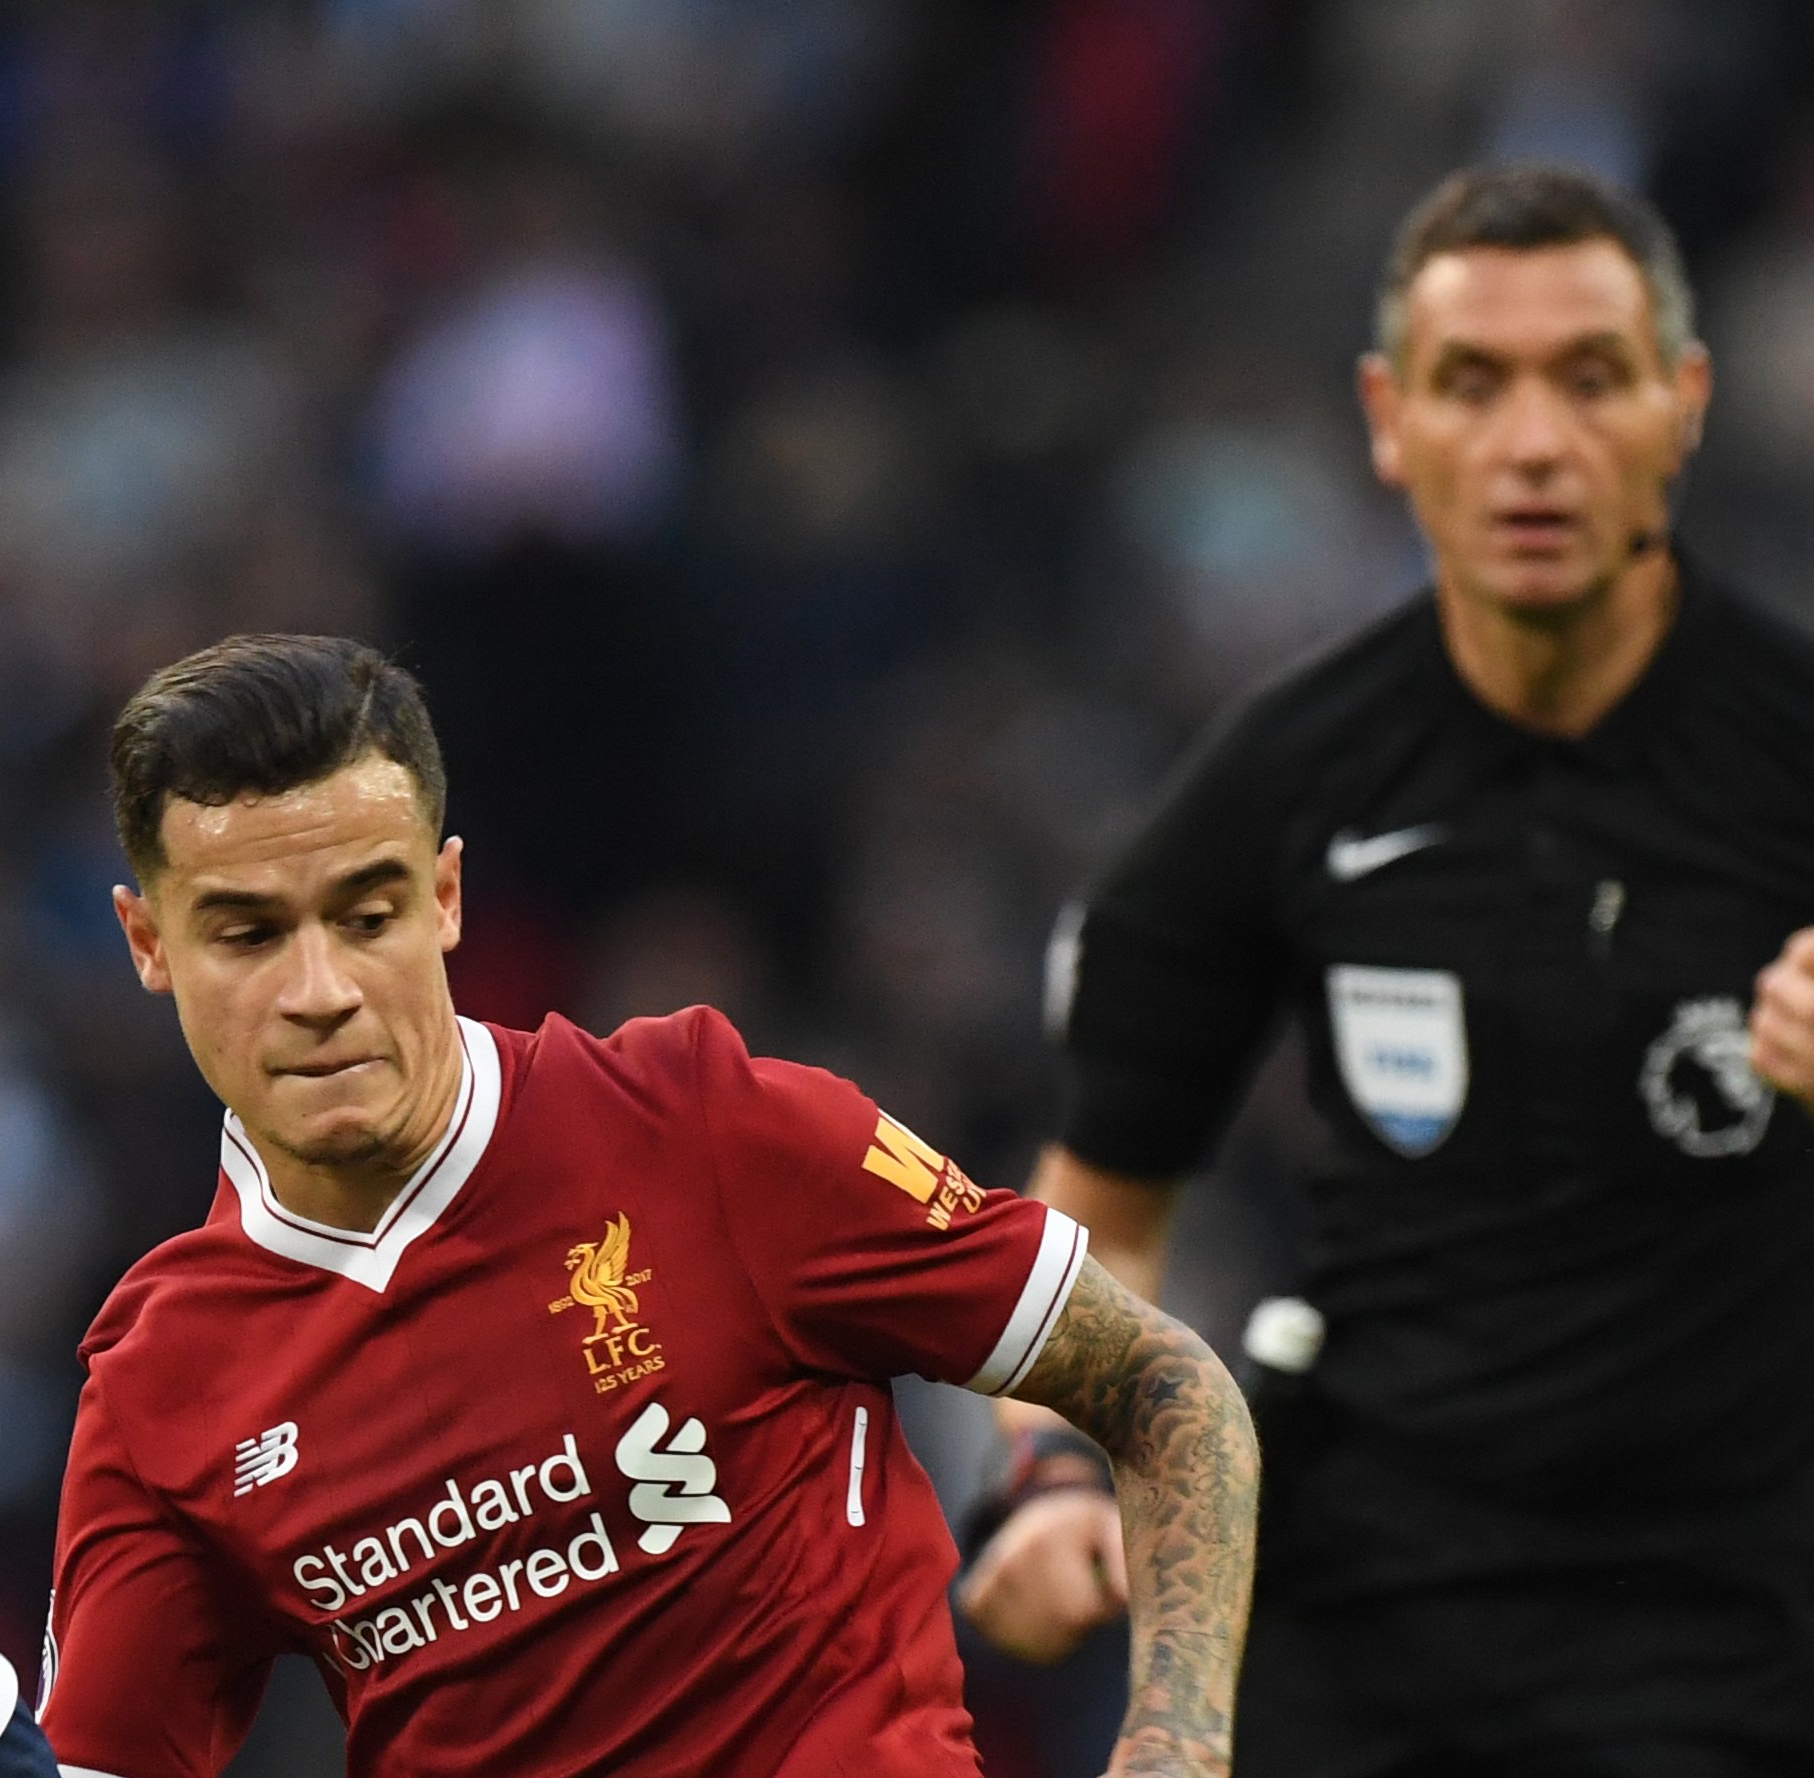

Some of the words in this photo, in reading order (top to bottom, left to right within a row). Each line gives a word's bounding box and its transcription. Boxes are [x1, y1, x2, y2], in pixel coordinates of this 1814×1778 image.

[594, 1374, 619, 1394] 125
[616, 1355, 666, 1384] YEARS
[292, 1433, 592, 1611] Standard
